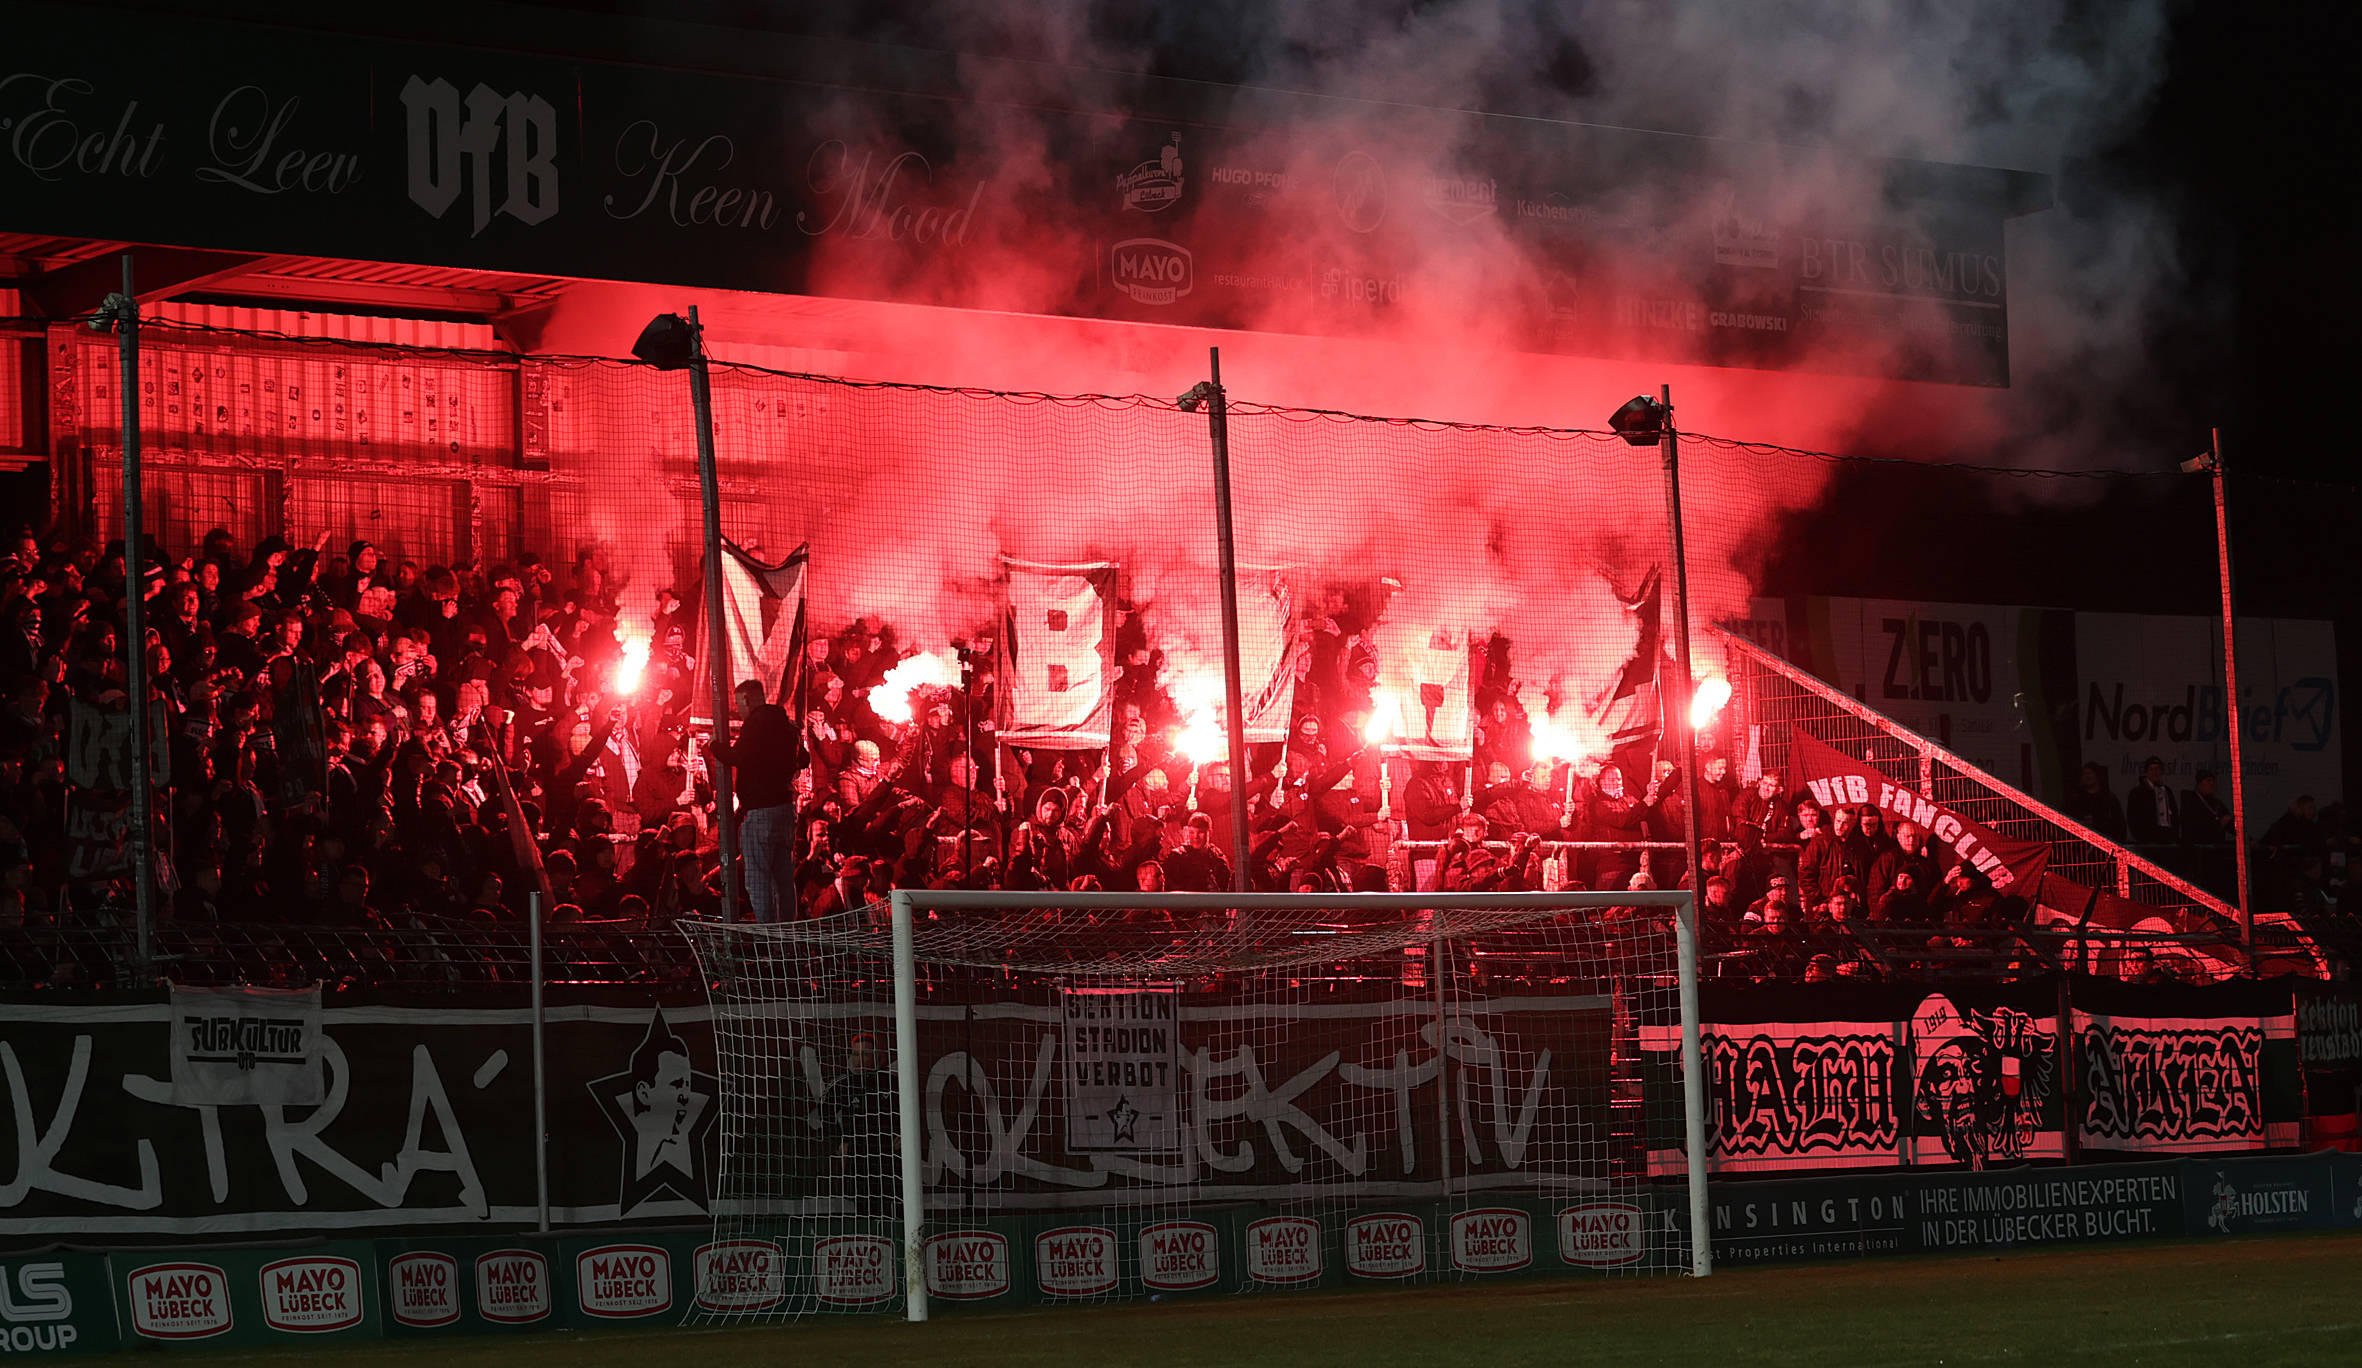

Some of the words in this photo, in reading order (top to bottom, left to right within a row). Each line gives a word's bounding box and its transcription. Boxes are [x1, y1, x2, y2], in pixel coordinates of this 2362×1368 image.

[0, 73, 166, 181] Echt
[604, 119, 782, 231] Keen
[1212, 167, 1252, 185] HUGO
[1120, 253, 1185, 282] MAYO
[1802, 237, 1870, 284] BTR
[1881, 245, 2000, 296] SUMUS
[1710, 312, 1786, 331] GRABOWSKI
[2085, 681, 2291, 743] NordBief
[1807, 775, 1869, 807] VfB
[1879, 782, 2016, 889] FANCLUB
[1069, 994, 1170, 1019] SEKTION
[1924, 1006, 1947, 1035] 1919
[1076, 1027, 1166, 1053] STADION
[1076, 1062, 1168, 1087] VERBOT
[1920, 1187, 1958, 1214] IHRE
[1963, 1176, 2176, 1213] IMMOBILIENEXPERTEN
[2241, 1190, 2311, 1216] HOLSTEN
[1572, 1214, 1629, 1233] MAYO
[1664, 1195, 1904, 1231] KNSINGTON
[1259, 1227, 1309, 1248] MAYO
[1358, 1223, 1411, 1244] MAYO
[1465, 1218, 1517, 1239] MAYO
[1922, 1220, 1939, 1246] IN
[1945, 1219, 1979, 1245] DER
[1984, 1213, 2080, 1242] LÜBECKER
[2085, 1208, 2156, 1237] BUCHT.
[937, 1242, 994, 1263] MAYO
[1049, 1238, 1103, 1260] MAYO
[1153, 1232, 1205, 1254] MAYO
[1359, 1244, 1412, 1261] LÜBECK
[1465, 1239, 1518, 1256] LÜBECK
[1573, 1233, 1630, 1250] LÜBECK
[1730, 1243, 1804, 1260] Properties
[1813, 1237, 1898, 1253] International
[708, 1250, 769, 1274] MAYO
[828, 1246, 882, 1268] MAYO
[1155, 1254, 1206, 1272] LÜBECK
[1261, 1248, 1309, 1265] LÜBECK
[401, 1264, 446, 1287] MAYO
[487, 1261, 536, 1285] MAYO
[592, 1256, 656, 1280] MAYO
[829, 1268, 882, 1287] LÜBECK
[938, 1264, 995, 1281] LÜBECK
[1051, 1261, 1104, 1278] LÜBECK
[145, 1275, 212, 1299] MAYO
[276, 1268, 345, 1294] MAYO
[594, 1279, 656, 1299] LÜBECK
[711, 1274, 769, 1293] LÜBECK
[279, 1292, 346, 1313] LÜBECK
[403, 1288, 448, 1307] LÜBECK
[489, 1285, 538, 1304] LÜBECK
[149, 1299, 215, 1319] LÜBECK
